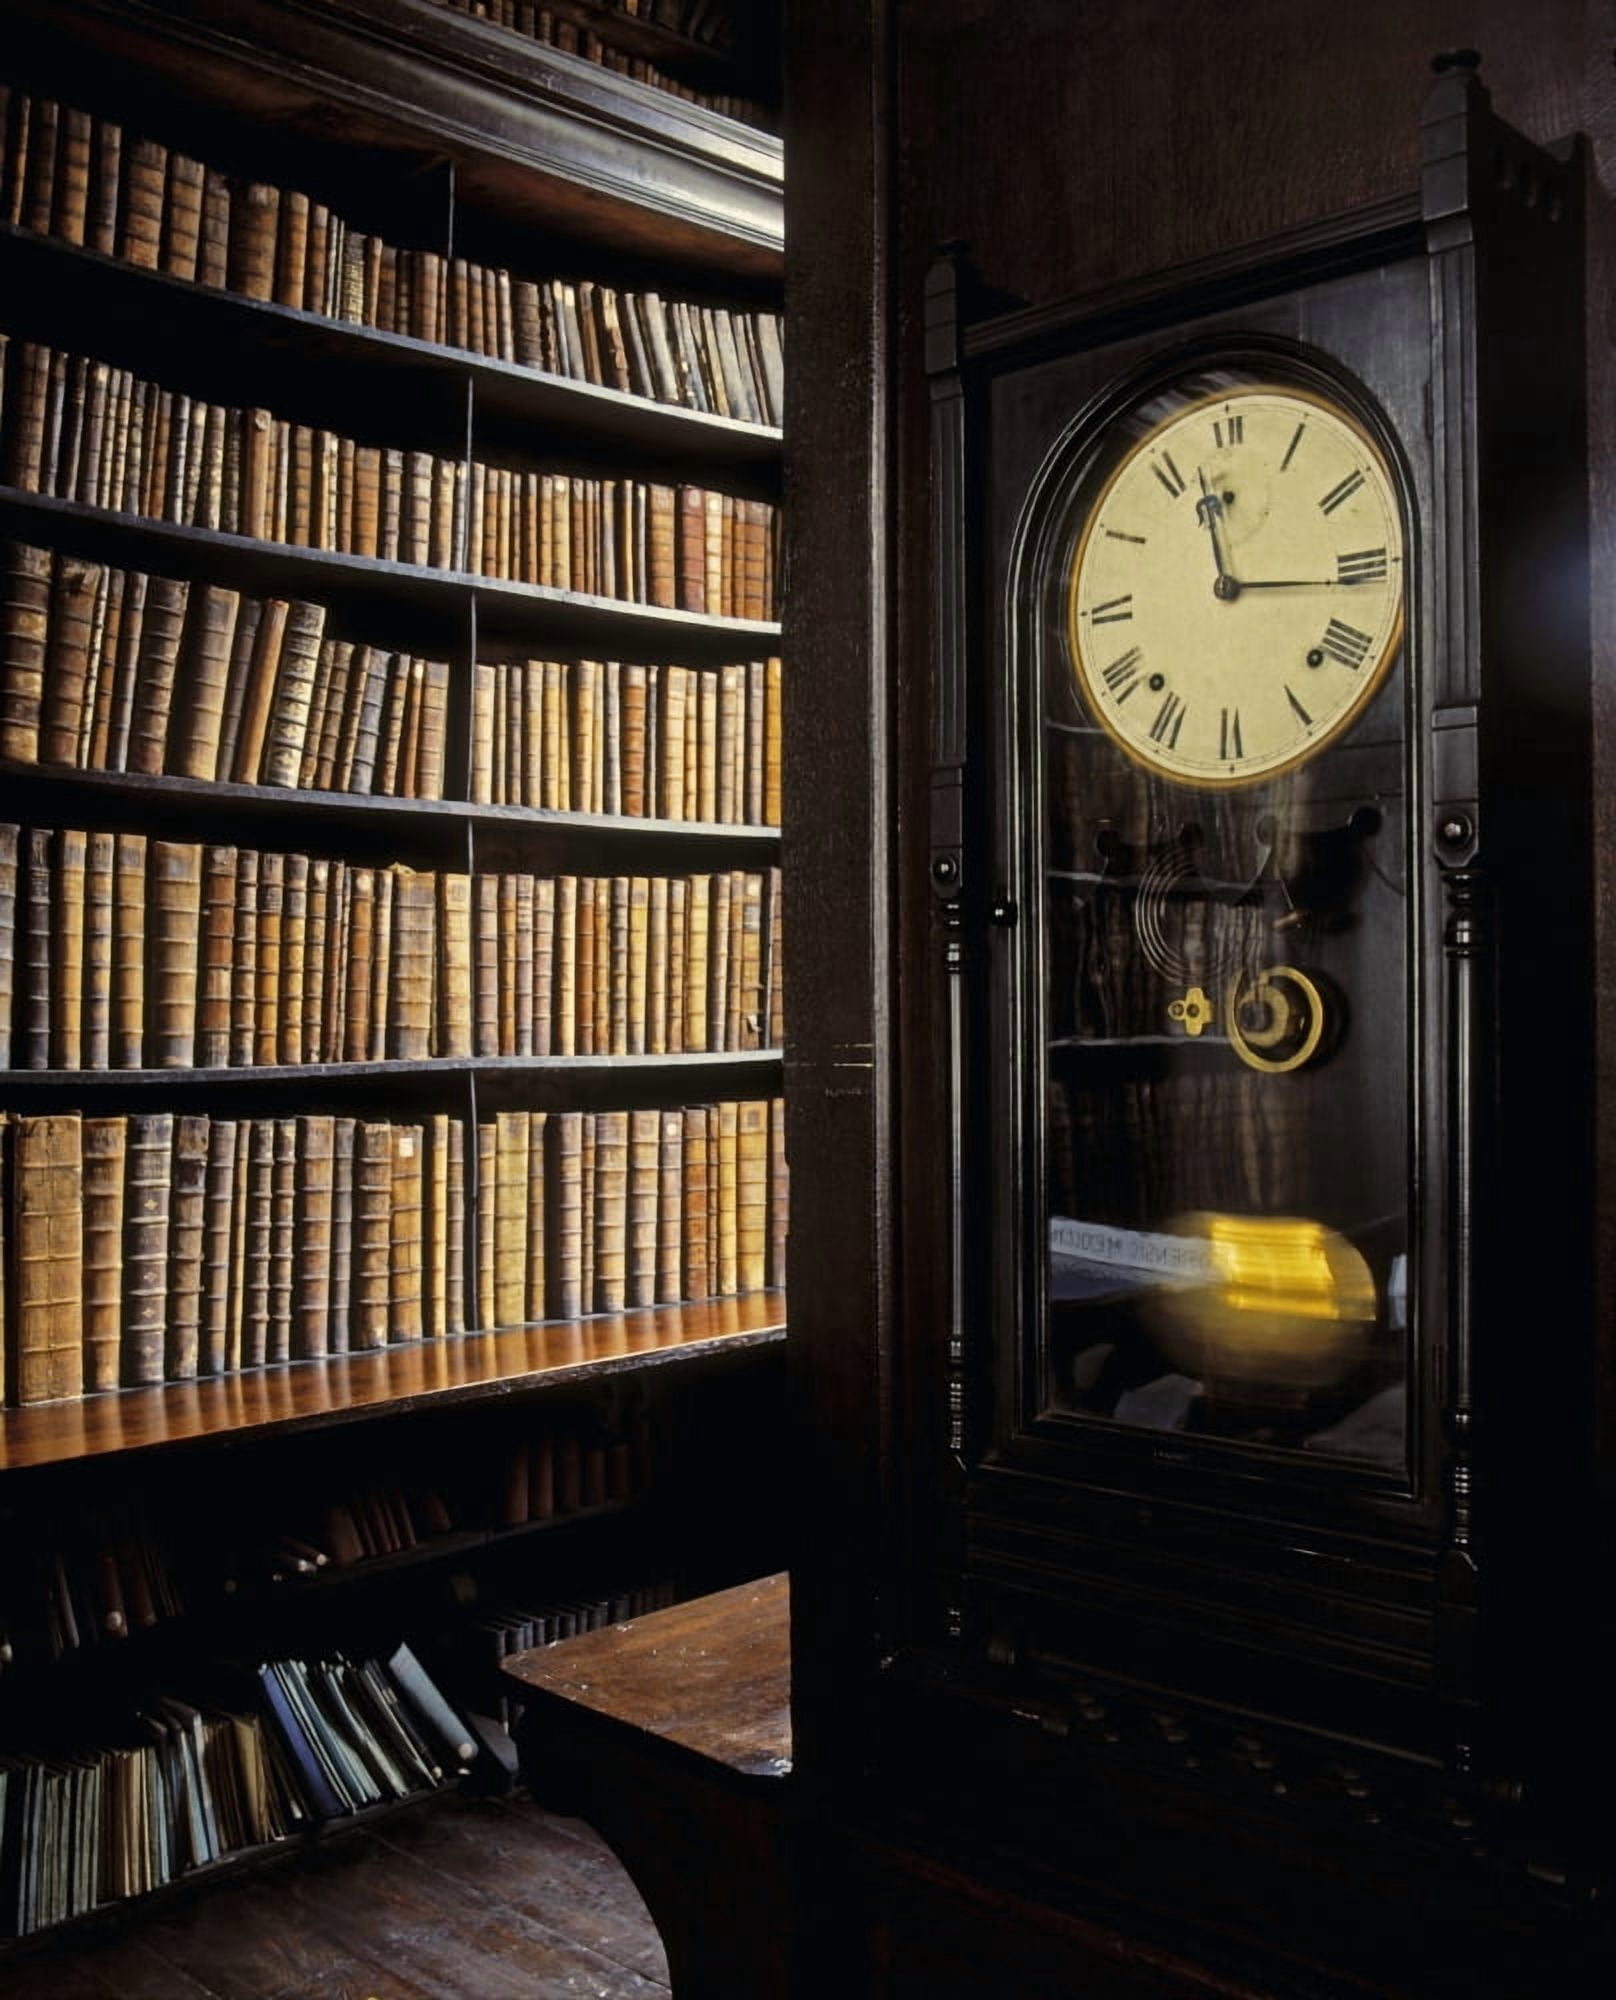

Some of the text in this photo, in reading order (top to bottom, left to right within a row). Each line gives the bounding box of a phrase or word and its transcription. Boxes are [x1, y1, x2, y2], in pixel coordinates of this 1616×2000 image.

[1318, 468, 1366, 516] II
[1336, 547, 1388, 584] III
[1319, 617, 1374, 672] IIII
